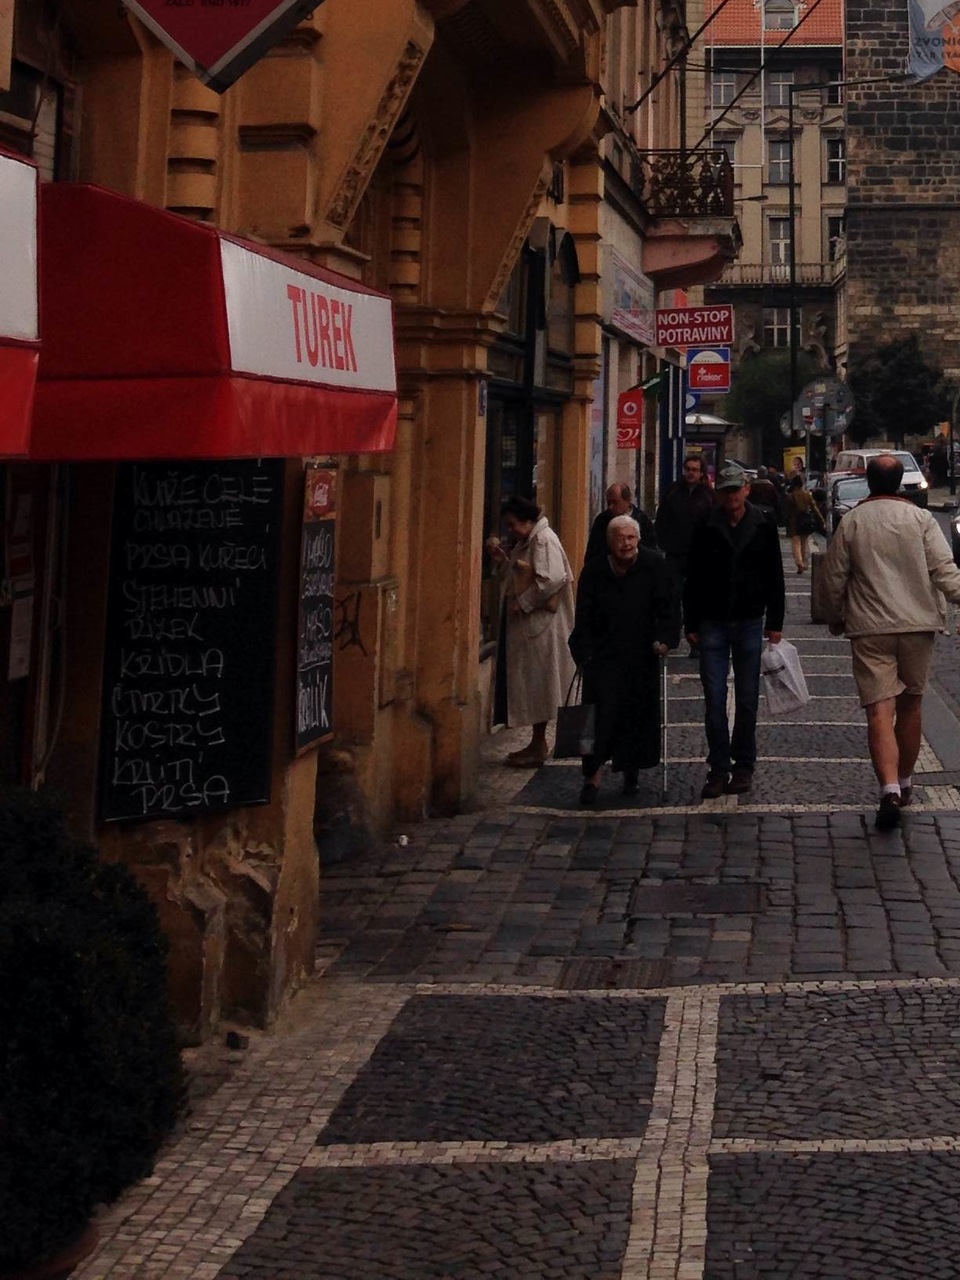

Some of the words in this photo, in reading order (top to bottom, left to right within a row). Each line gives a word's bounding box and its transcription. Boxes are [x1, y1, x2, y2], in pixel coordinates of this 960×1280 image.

[287, 284, 358, 372] TUREK
[658, 310, 729, 325] NON-STOP
[658, 326, 729, 343] POTRAVINY
[124, 541, 190, 570] PRSA
[115, 719, 225, 751] KOSTRY
[130, 775, 230, 813] PRSA
